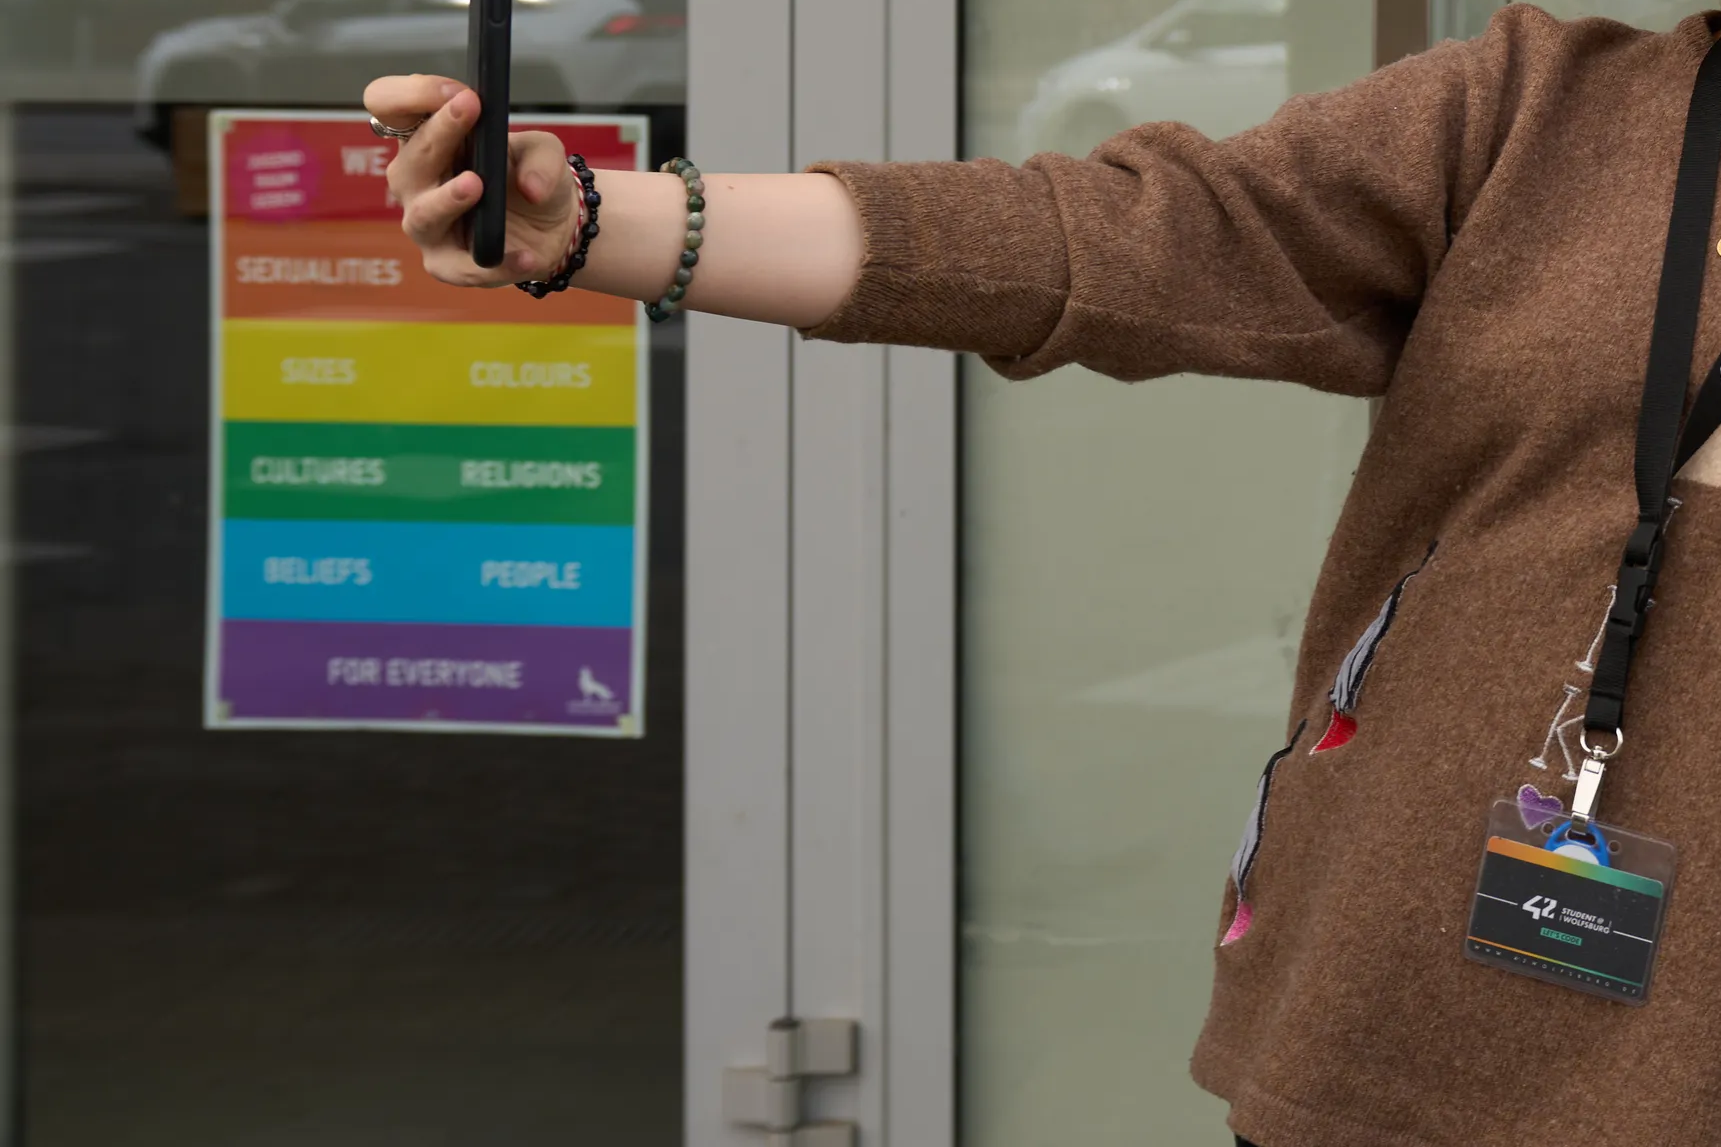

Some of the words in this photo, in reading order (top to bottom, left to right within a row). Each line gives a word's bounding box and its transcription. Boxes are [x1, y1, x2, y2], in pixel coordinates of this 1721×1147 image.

[340, 146, 390, 176] WE
[236, 255, 403, 287] SEXUALITIES
[280, 357, 358, 386] SIZES
[468, 360, 593, 390] COLOURS
[250, 456, 386, 487] CULTURES
[459, 459, 602, 491] RELIGIONS
[263, 556, 374, 587] BELIEFS
[480, 559, 582, 591] PEOPLE
[327, 656, 383, 686] FOR
[386, 656, 524, 690] EVERYONE
[1521, 894, 1558, 921] 42
[1560, 907, 1598, 923] STUDENT
[1560, 933, 1581, 946] CODE
[1562, 915, 1611, 935] WOLFSBURG
